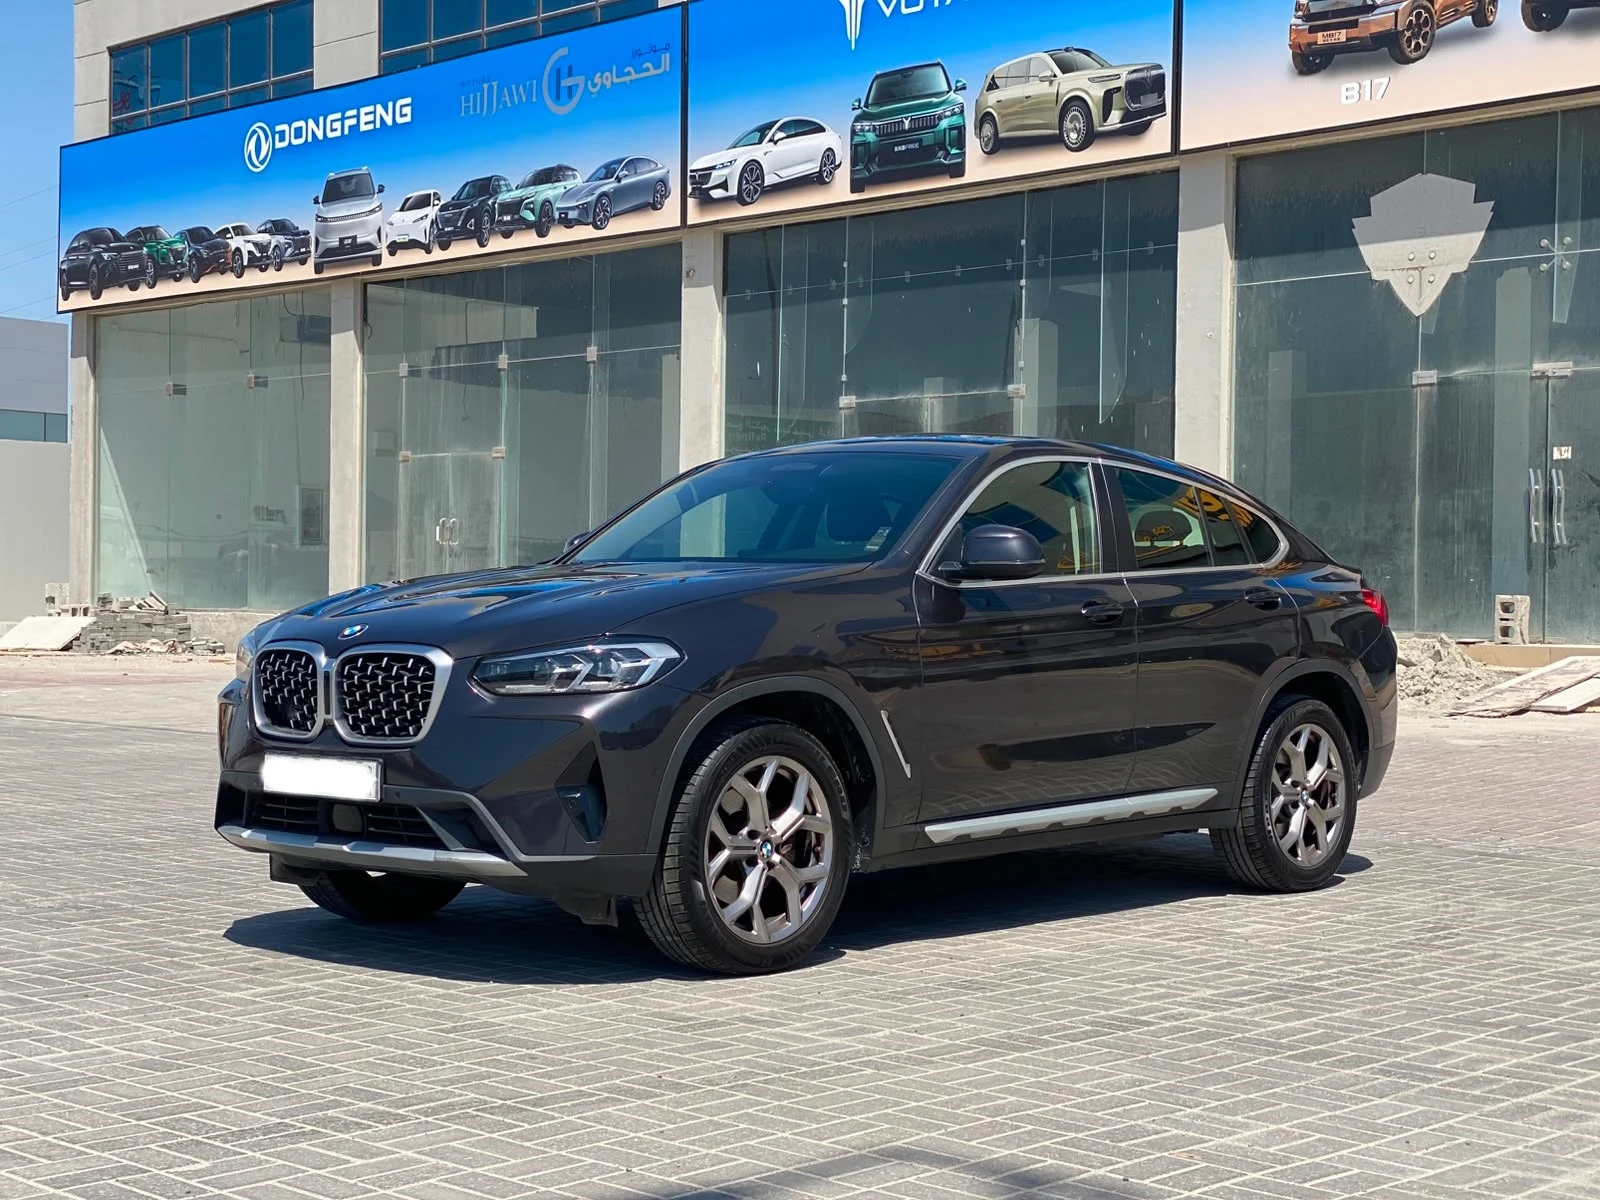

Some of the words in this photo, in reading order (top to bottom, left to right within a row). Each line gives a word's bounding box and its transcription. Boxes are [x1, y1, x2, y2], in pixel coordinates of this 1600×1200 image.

[588, 53, 670, 97] الحجاوي
[1340, 77, 1391, 105] 817
[460, 80, 537, 117] HIJJAWI
[274, 96, 412, 149] DONGFENG
